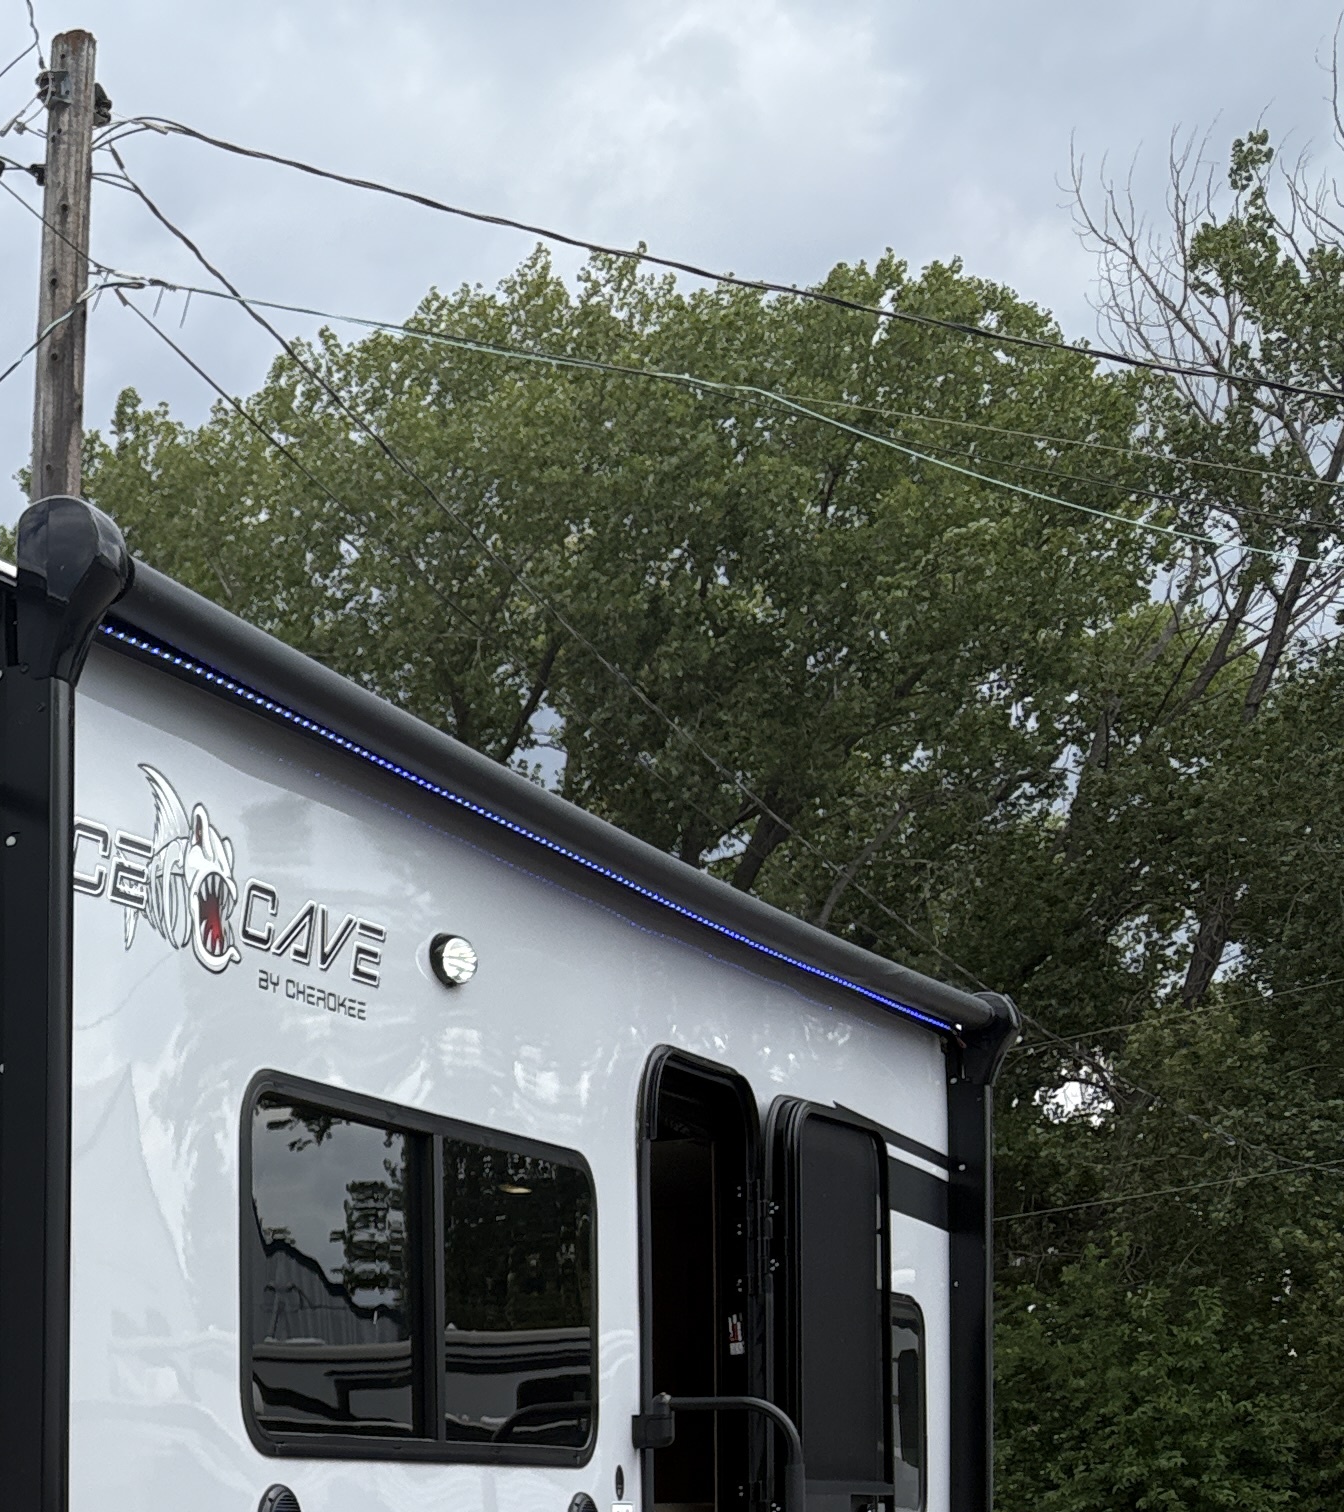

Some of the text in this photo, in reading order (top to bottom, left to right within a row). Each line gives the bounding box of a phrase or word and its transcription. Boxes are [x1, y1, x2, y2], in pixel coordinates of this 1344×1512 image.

[74, 816, 387, 988] CE CAVE
[258, 969, 366, 1021] BY CHEROKEE
